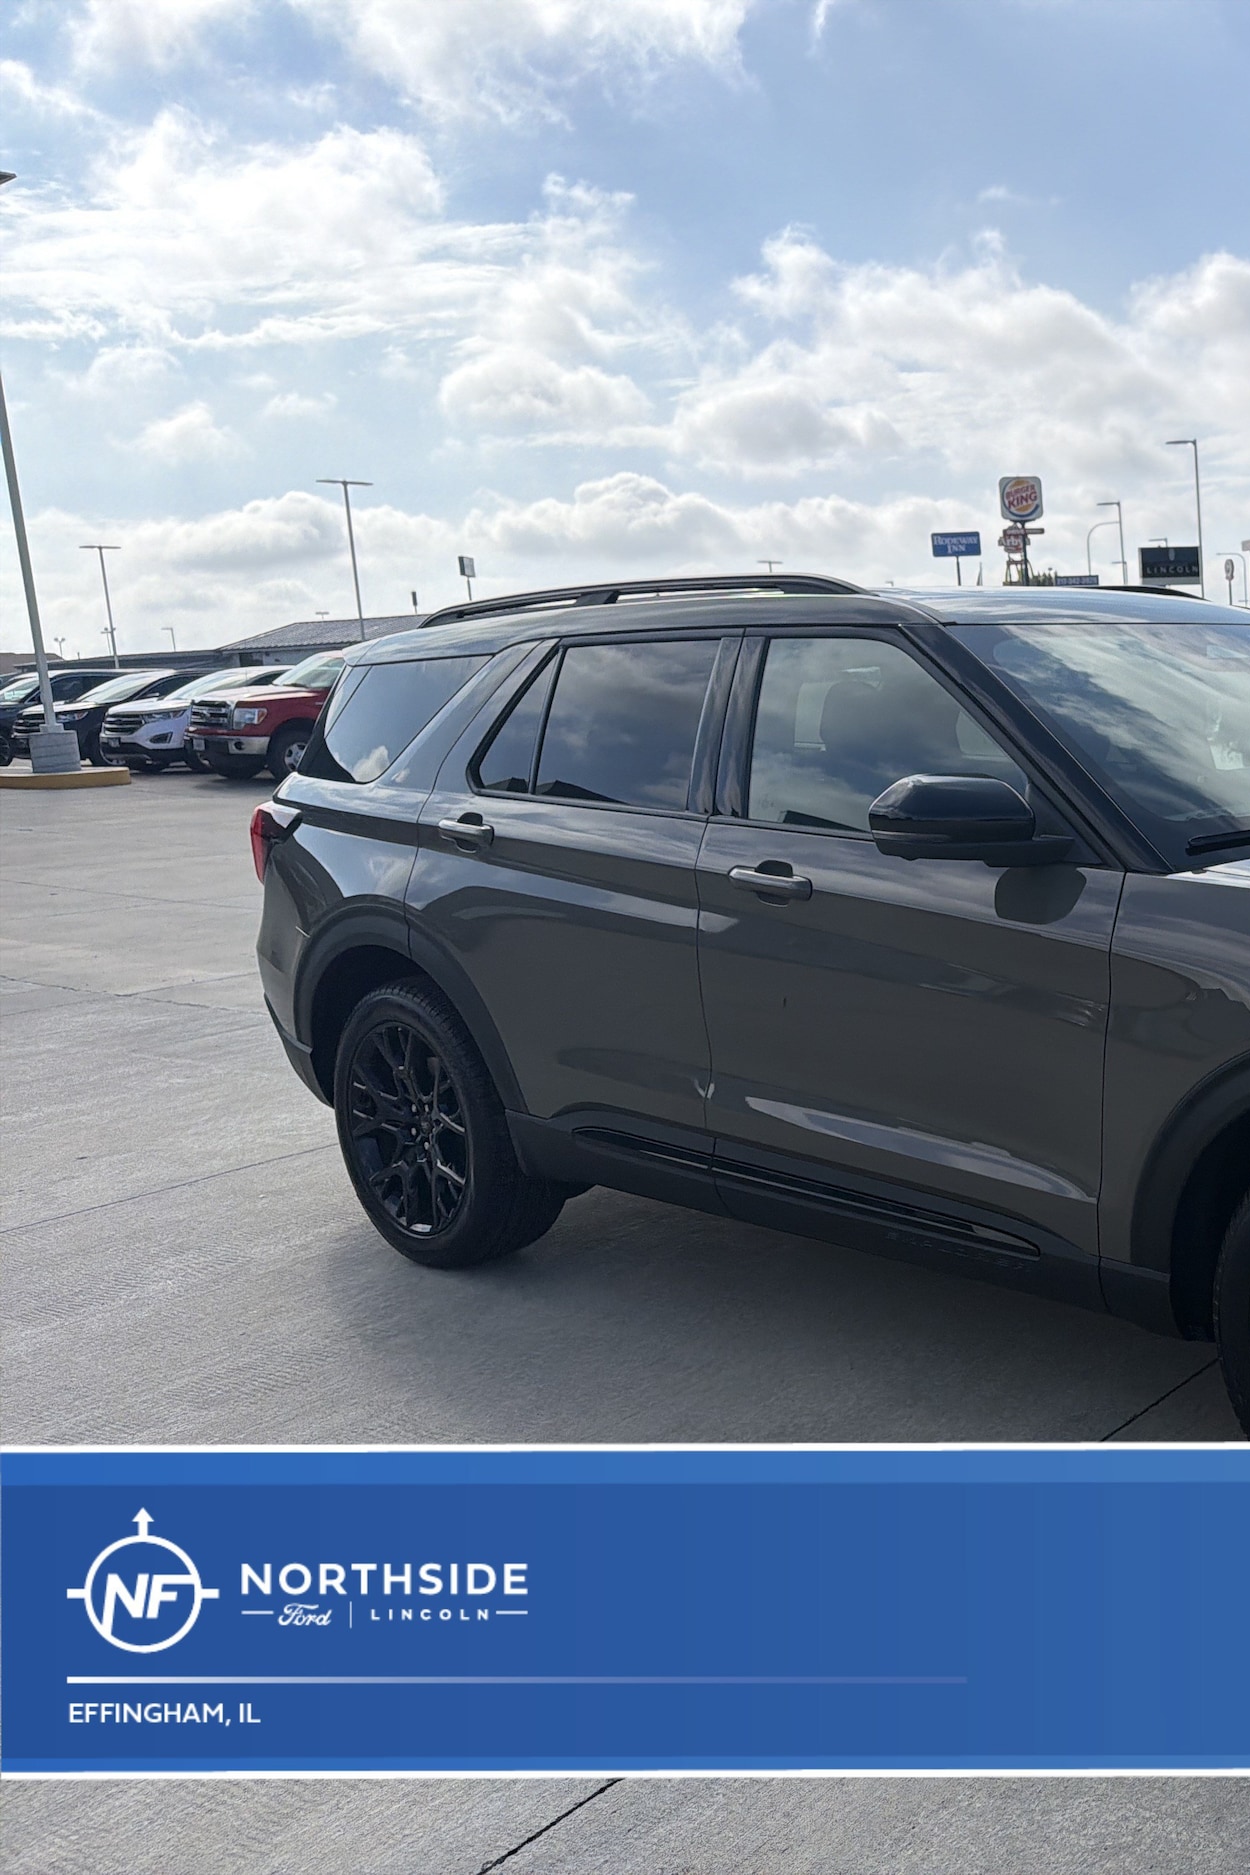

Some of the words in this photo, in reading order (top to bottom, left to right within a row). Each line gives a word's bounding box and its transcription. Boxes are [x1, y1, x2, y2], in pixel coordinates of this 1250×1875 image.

[1005, 484, 1036, 500] BURGER
[1008, 491, 1038, 509] KING
[1146, 565, 1199, 575] LINCOLN
